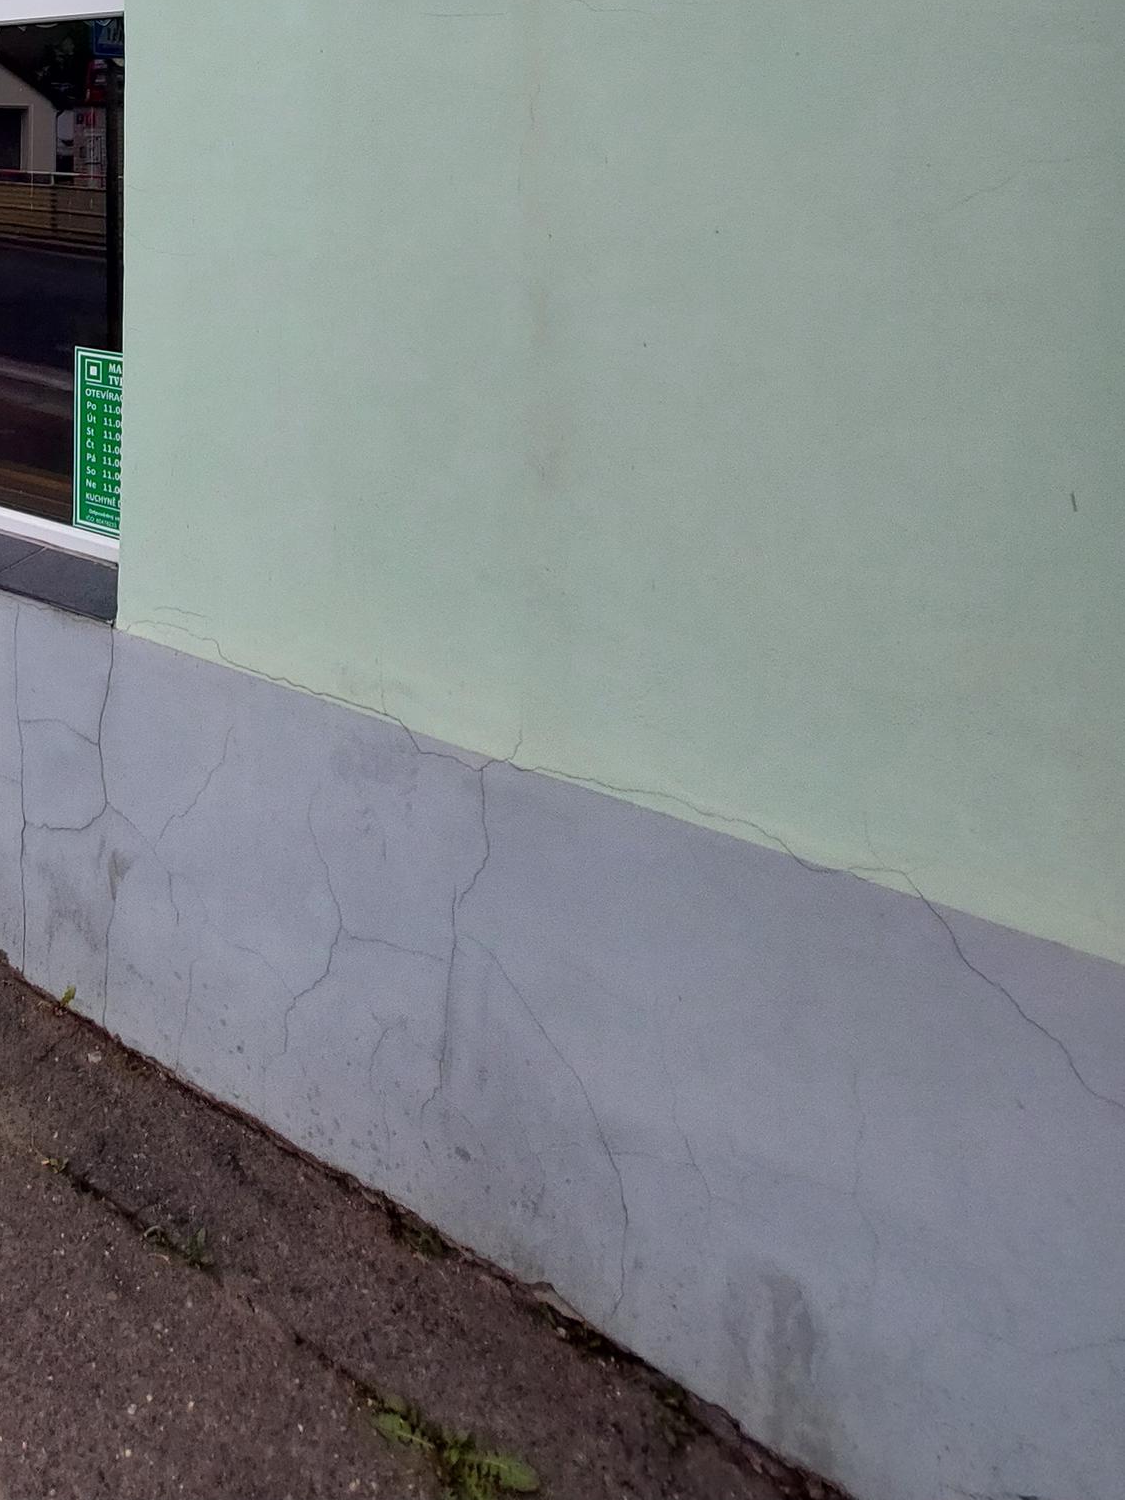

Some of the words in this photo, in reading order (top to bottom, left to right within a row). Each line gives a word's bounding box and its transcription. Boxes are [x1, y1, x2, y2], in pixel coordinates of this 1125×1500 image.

[103, 403, 122, 415] 11.0
[103, 417, 122, 428] 11.0
[103, 430, 122, 441] 11.0
[103, 443, 121, 455] 11.0
[103, 456, 121, 467] 11.0
[103, 469, 121, 481] 11.0
[103, 483, 121, 494] 11.0
